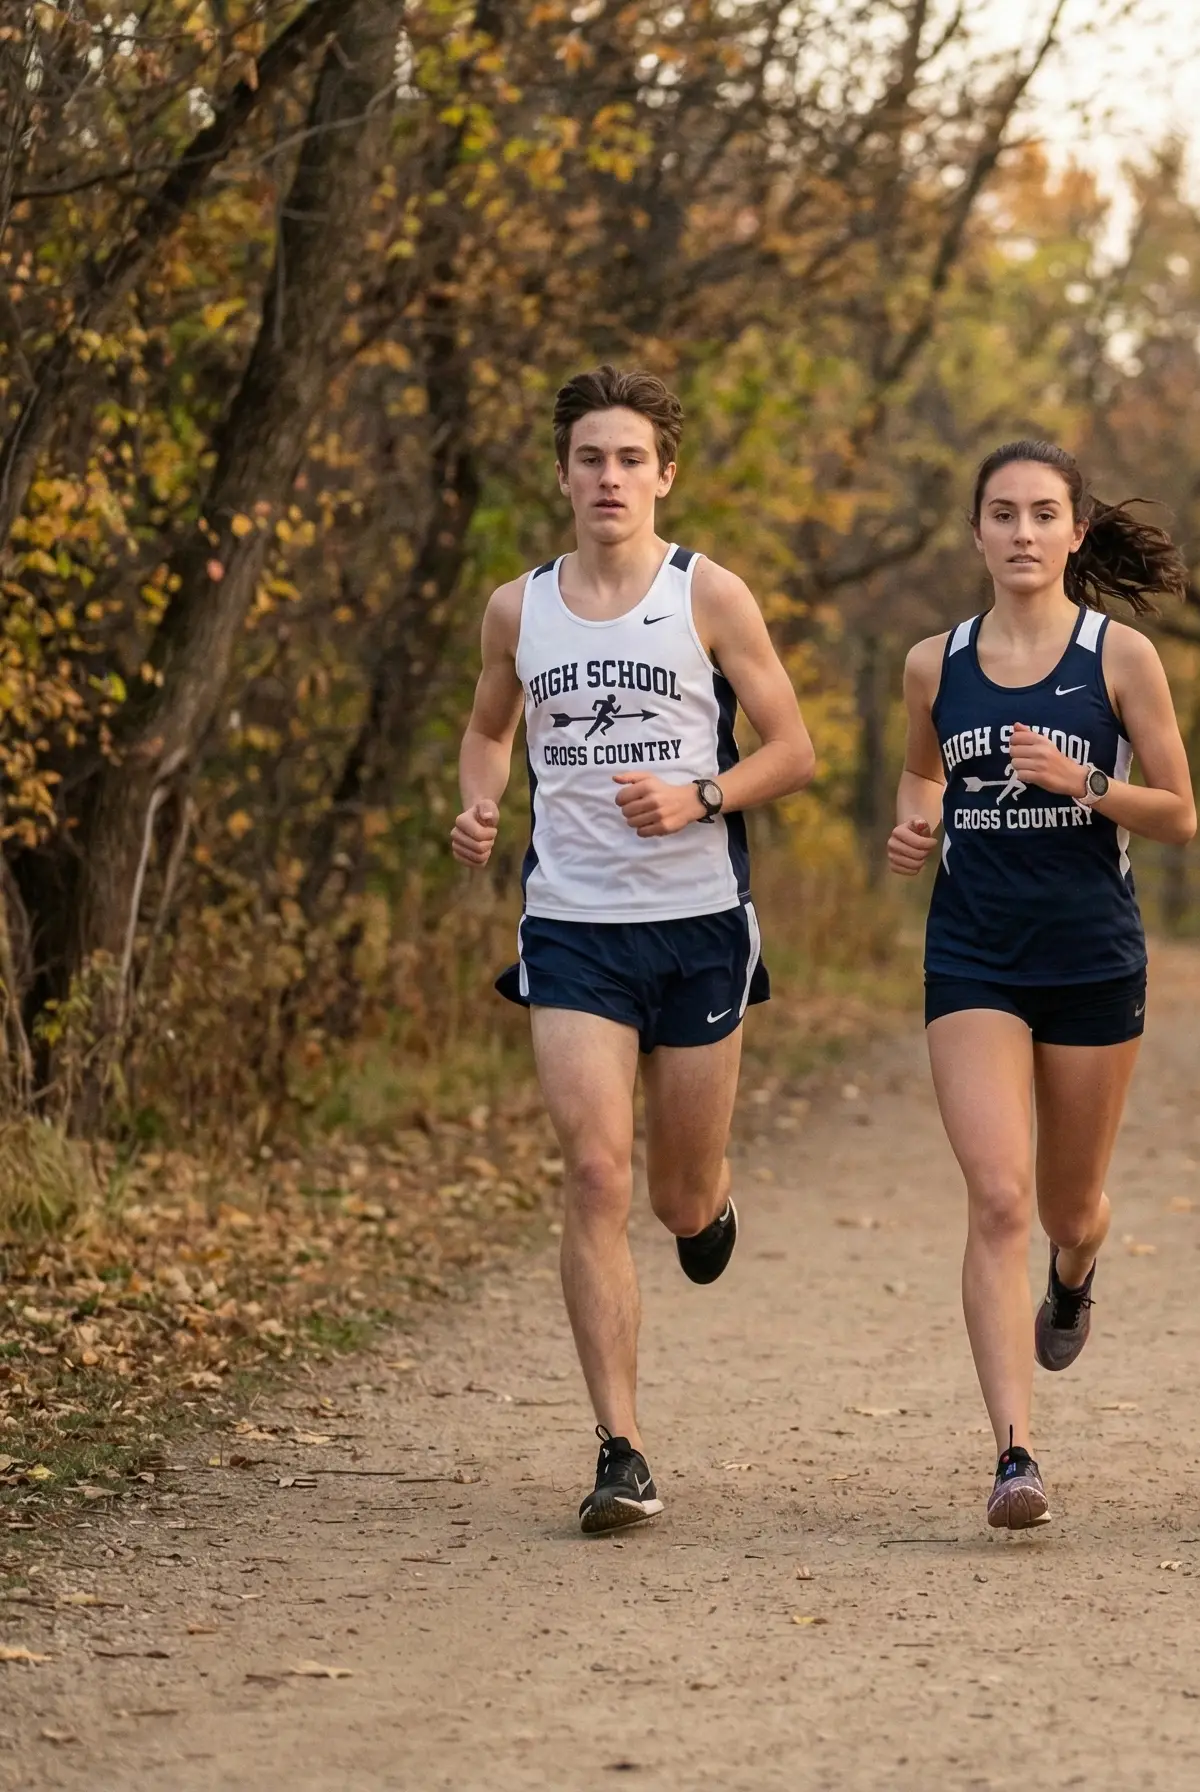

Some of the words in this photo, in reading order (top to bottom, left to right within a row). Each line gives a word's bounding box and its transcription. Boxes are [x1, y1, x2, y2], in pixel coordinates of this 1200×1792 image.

[529, 662, 578, 708] HIGH
[587, 660, 681, 701] SCHOOL
[544, 745, 588, 766] CROSS
[593, 739, 681, 765] COUNTRY
[943, 726, 992, 772] HIGH
[999, 725, 1091, 766] SOOL
[954, 808, 1001, 829] CROSS
[1006, 806, 1093, 829] COUNTRY
